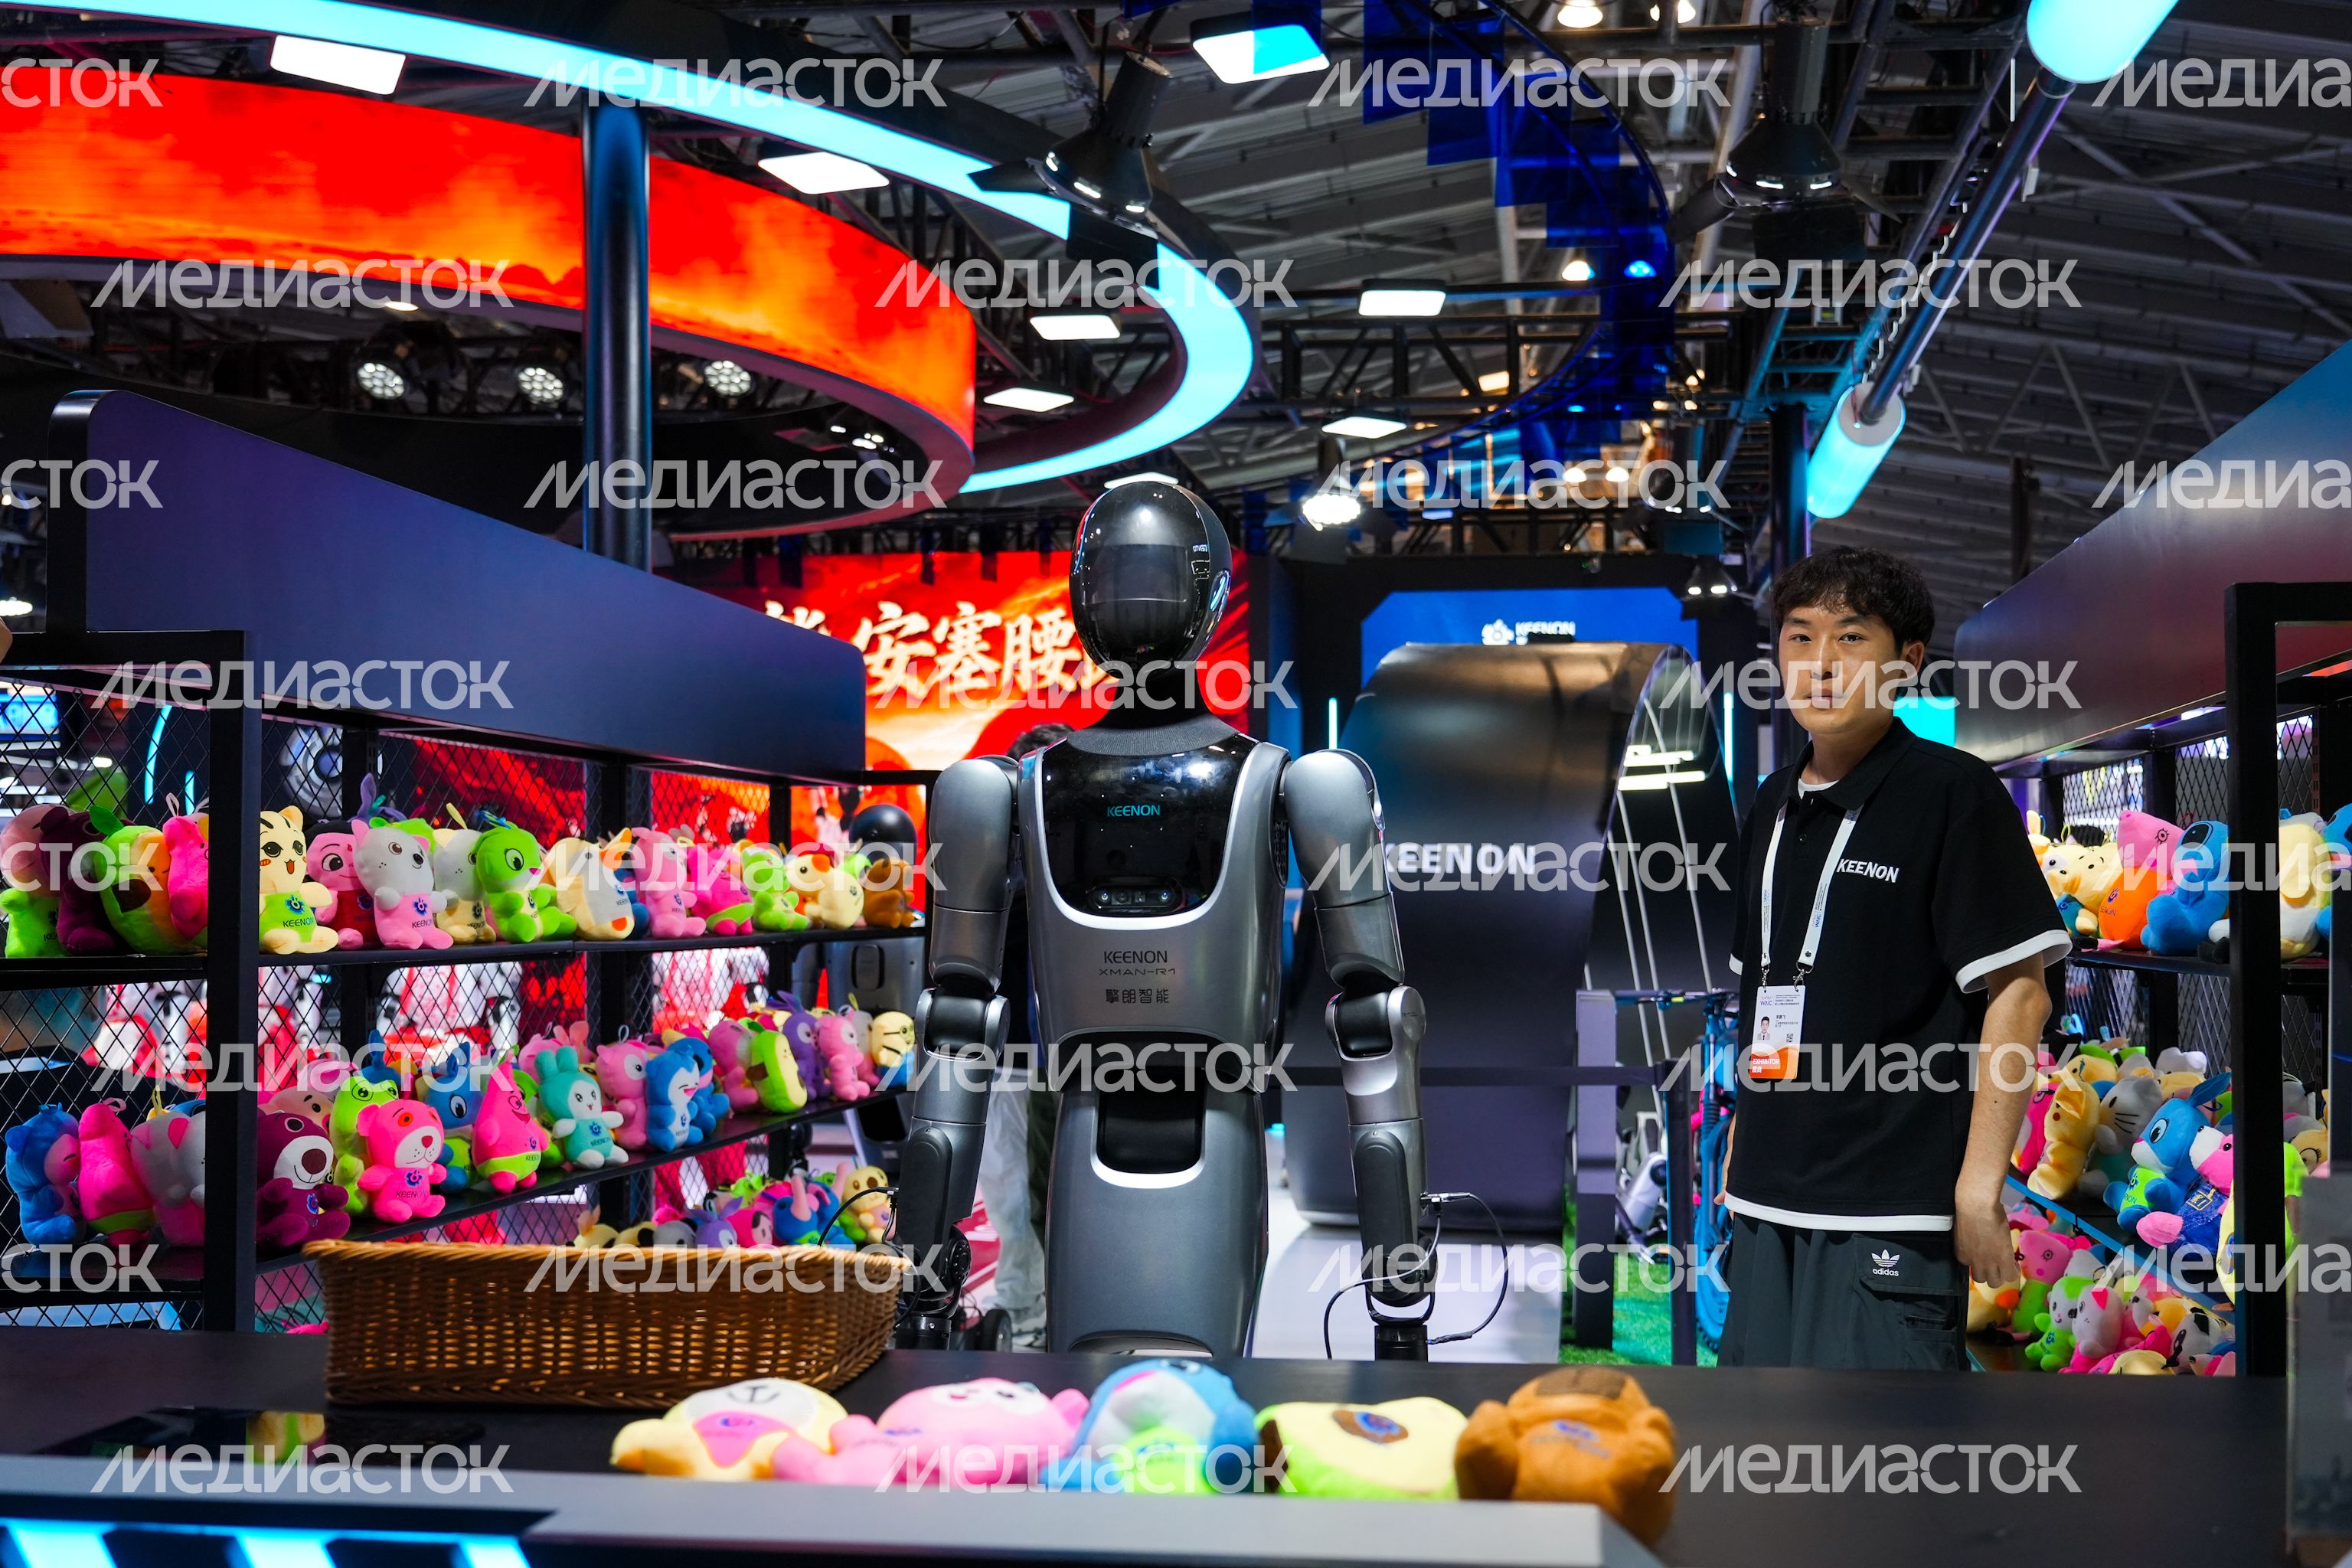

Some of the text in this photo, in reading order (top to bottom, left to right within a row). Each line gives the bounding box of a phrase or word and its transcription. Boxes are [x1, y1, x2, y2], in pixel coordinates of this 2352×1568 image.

[1107, 805, 1161, 817] KEENON
[1384, 843, 1536, 875] KEENON
[1837, 858, 1900, 884] KEENON
[283, 917, 314, 927] KEENON
[1104, 950, 1168, 964] KEENON
[1099, 968, 1176, 976] XMAN-R1
[1106, 988, 1170, 1004] 擎朗智能
[1873, 1268, 1900, 1276] adidas
